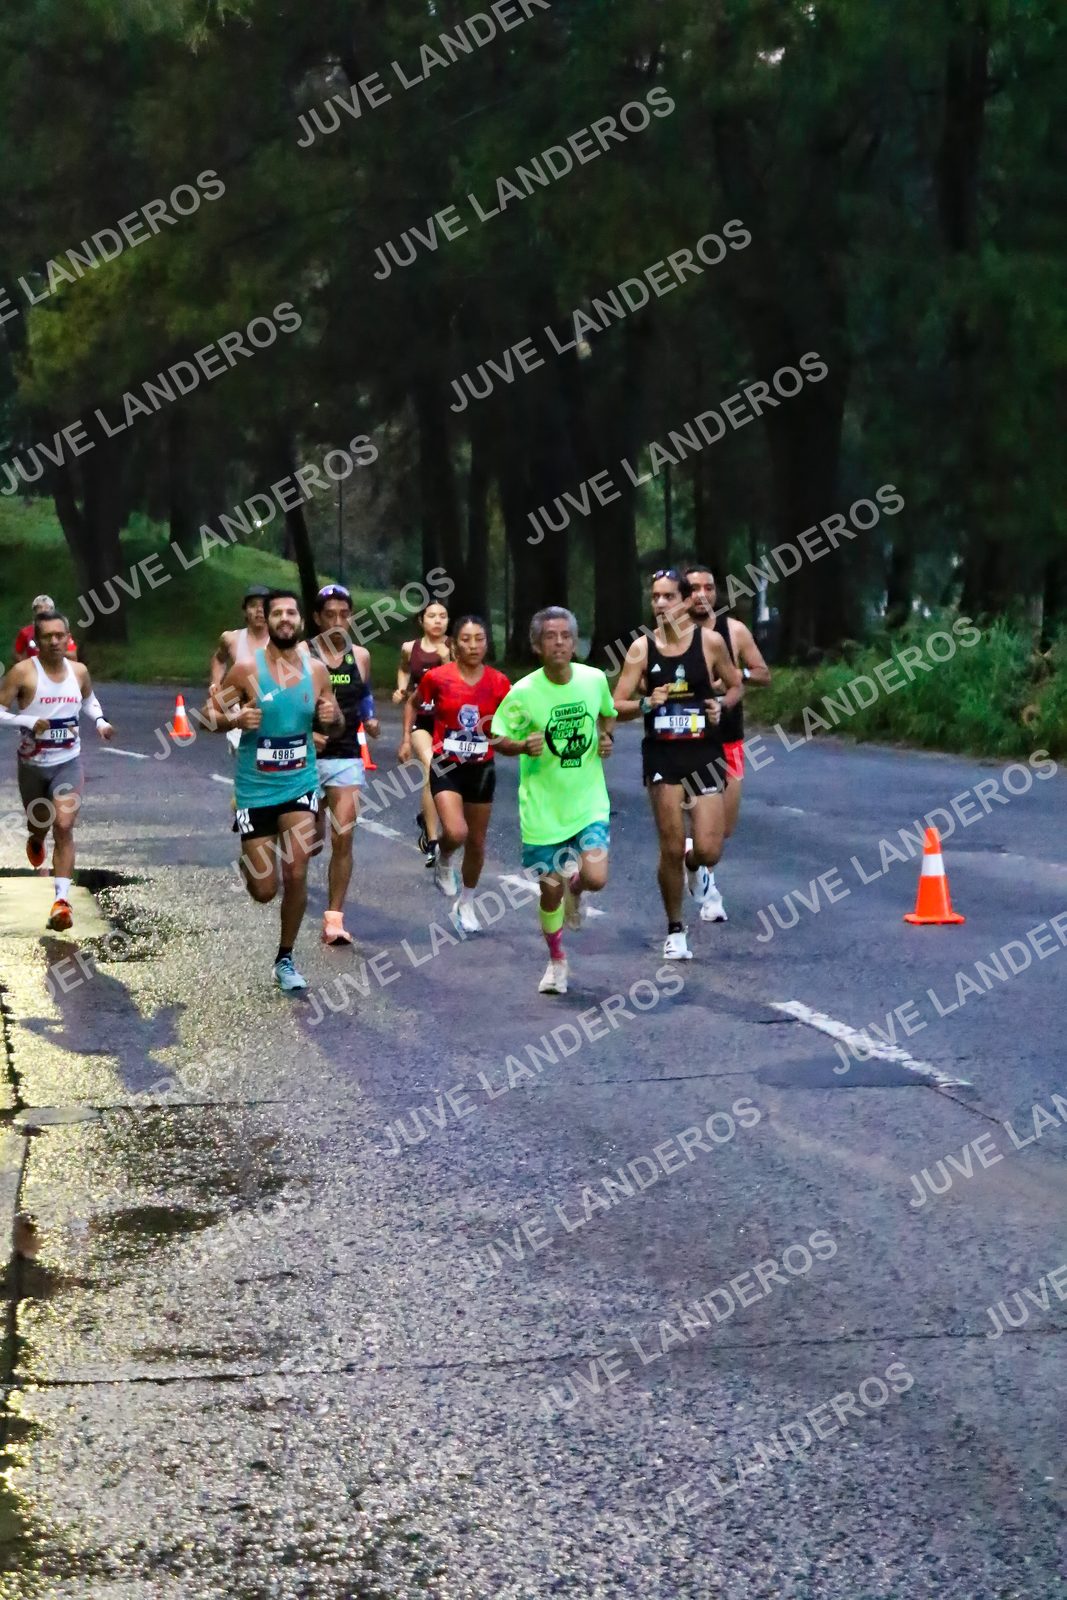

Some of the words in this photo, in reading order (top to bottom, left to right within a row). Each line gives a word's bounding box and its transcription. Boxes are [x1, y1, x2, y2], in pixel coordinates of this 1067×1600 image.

[554, 705, 584, 718] BIMBO
[669, 716, 690, 727] 5102
[50, 729, 68, 739] 5178
[272, 749, 295, 760] 4985
